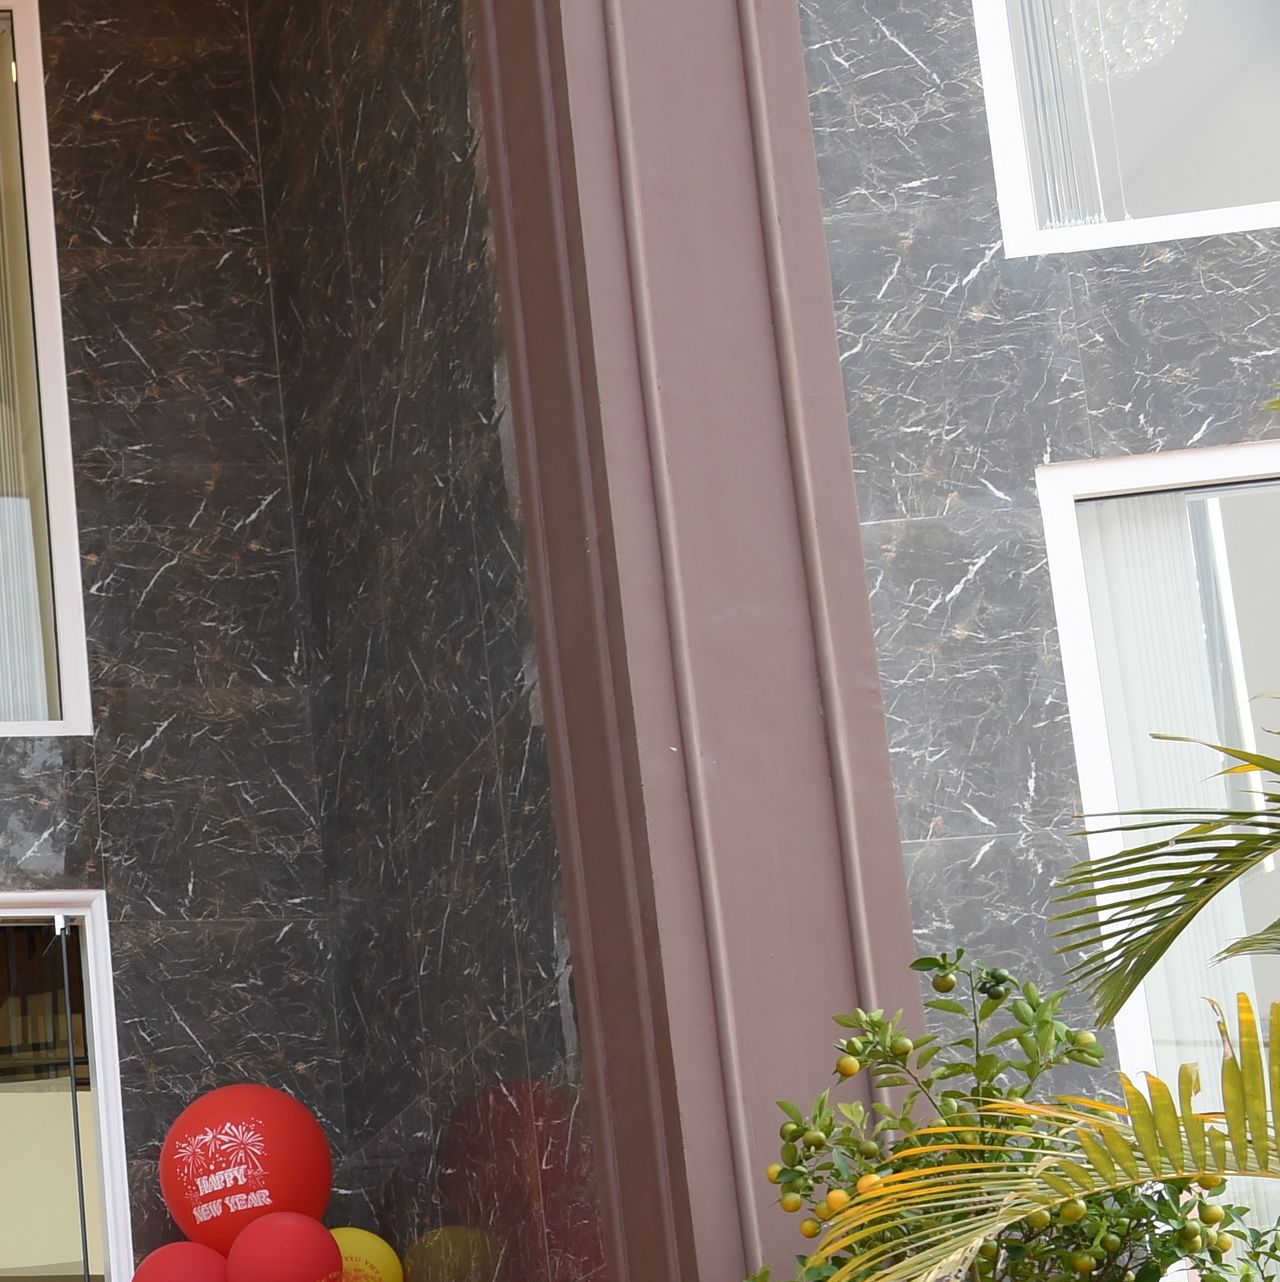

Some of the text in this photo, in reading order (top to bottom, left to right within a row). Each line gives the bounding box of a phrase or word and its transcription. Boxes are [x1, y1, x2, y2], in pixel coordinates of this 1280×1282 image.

[196, 1165, 248, 1197] HAPPY
[192, 1189, 273, 1224] NEW YEAR
